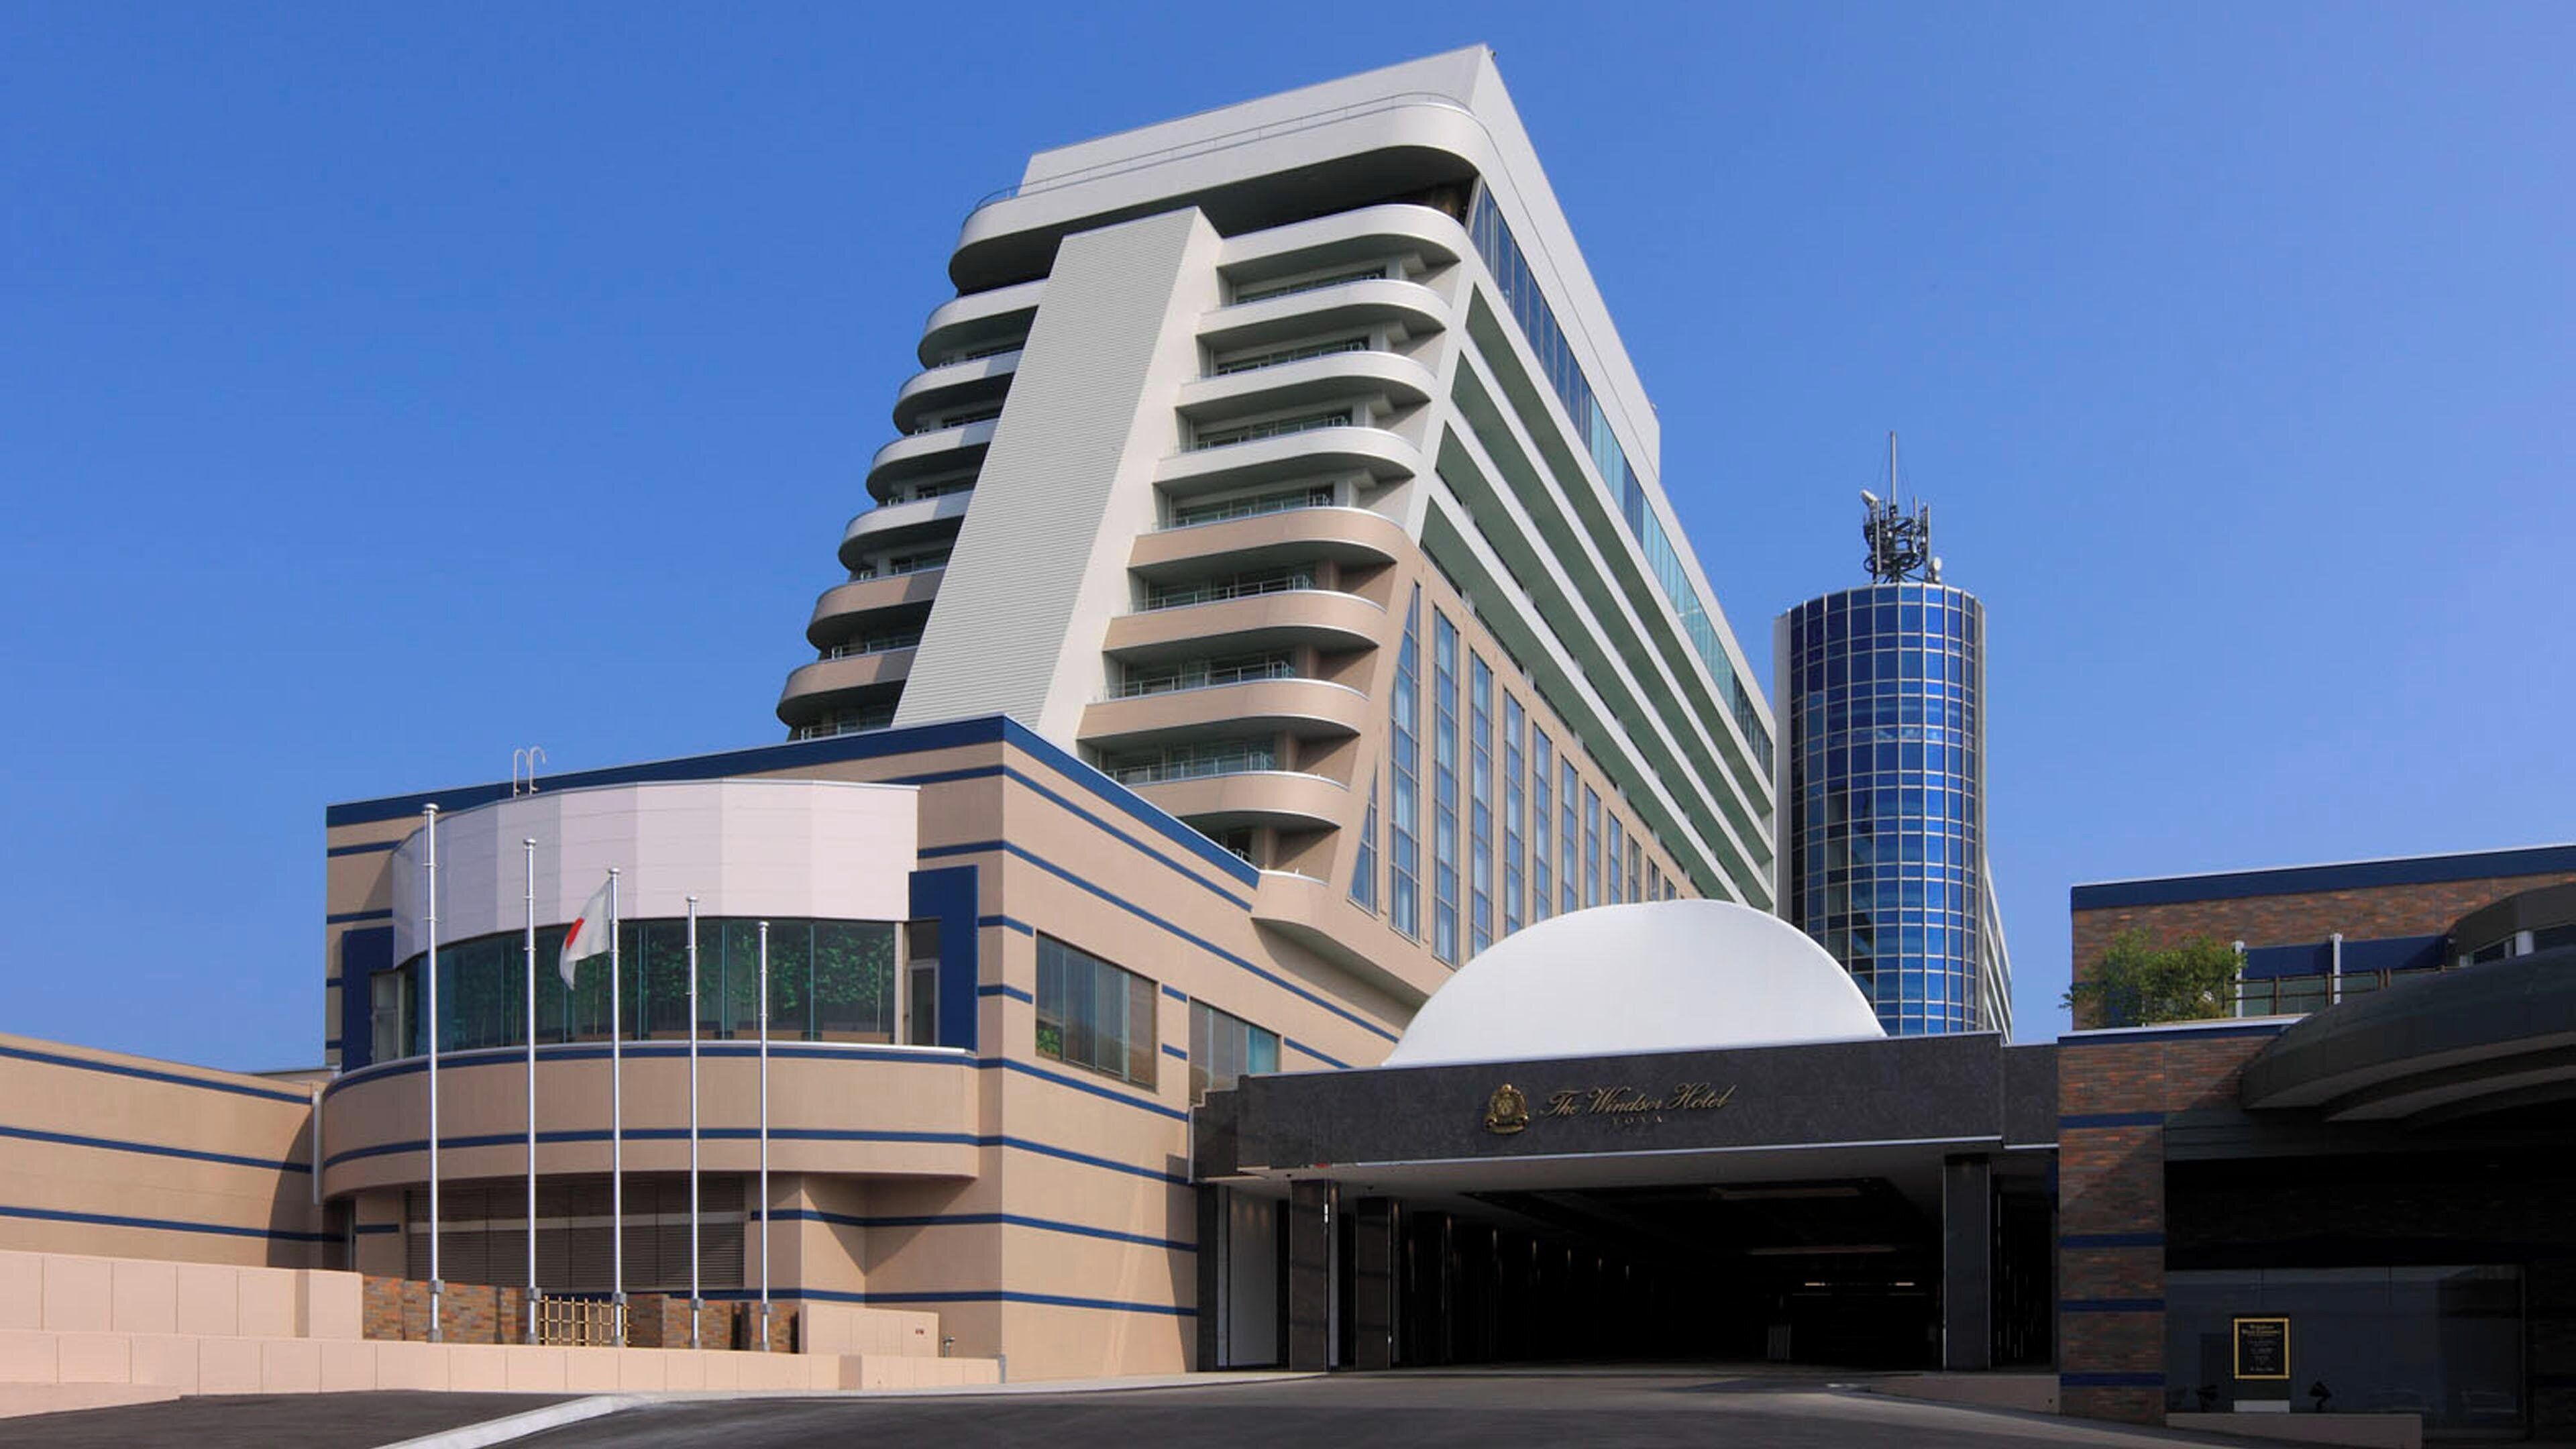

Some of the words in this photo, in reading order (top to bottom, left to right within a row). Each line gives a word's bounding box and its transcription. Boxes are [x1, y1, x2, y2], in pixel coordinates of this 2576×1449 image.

[1544, 1089, 1582, 1118] The
[1587, 1085, 1662, 1114] Windsor
[1665, 1081, 1737, 1110] Hotel
